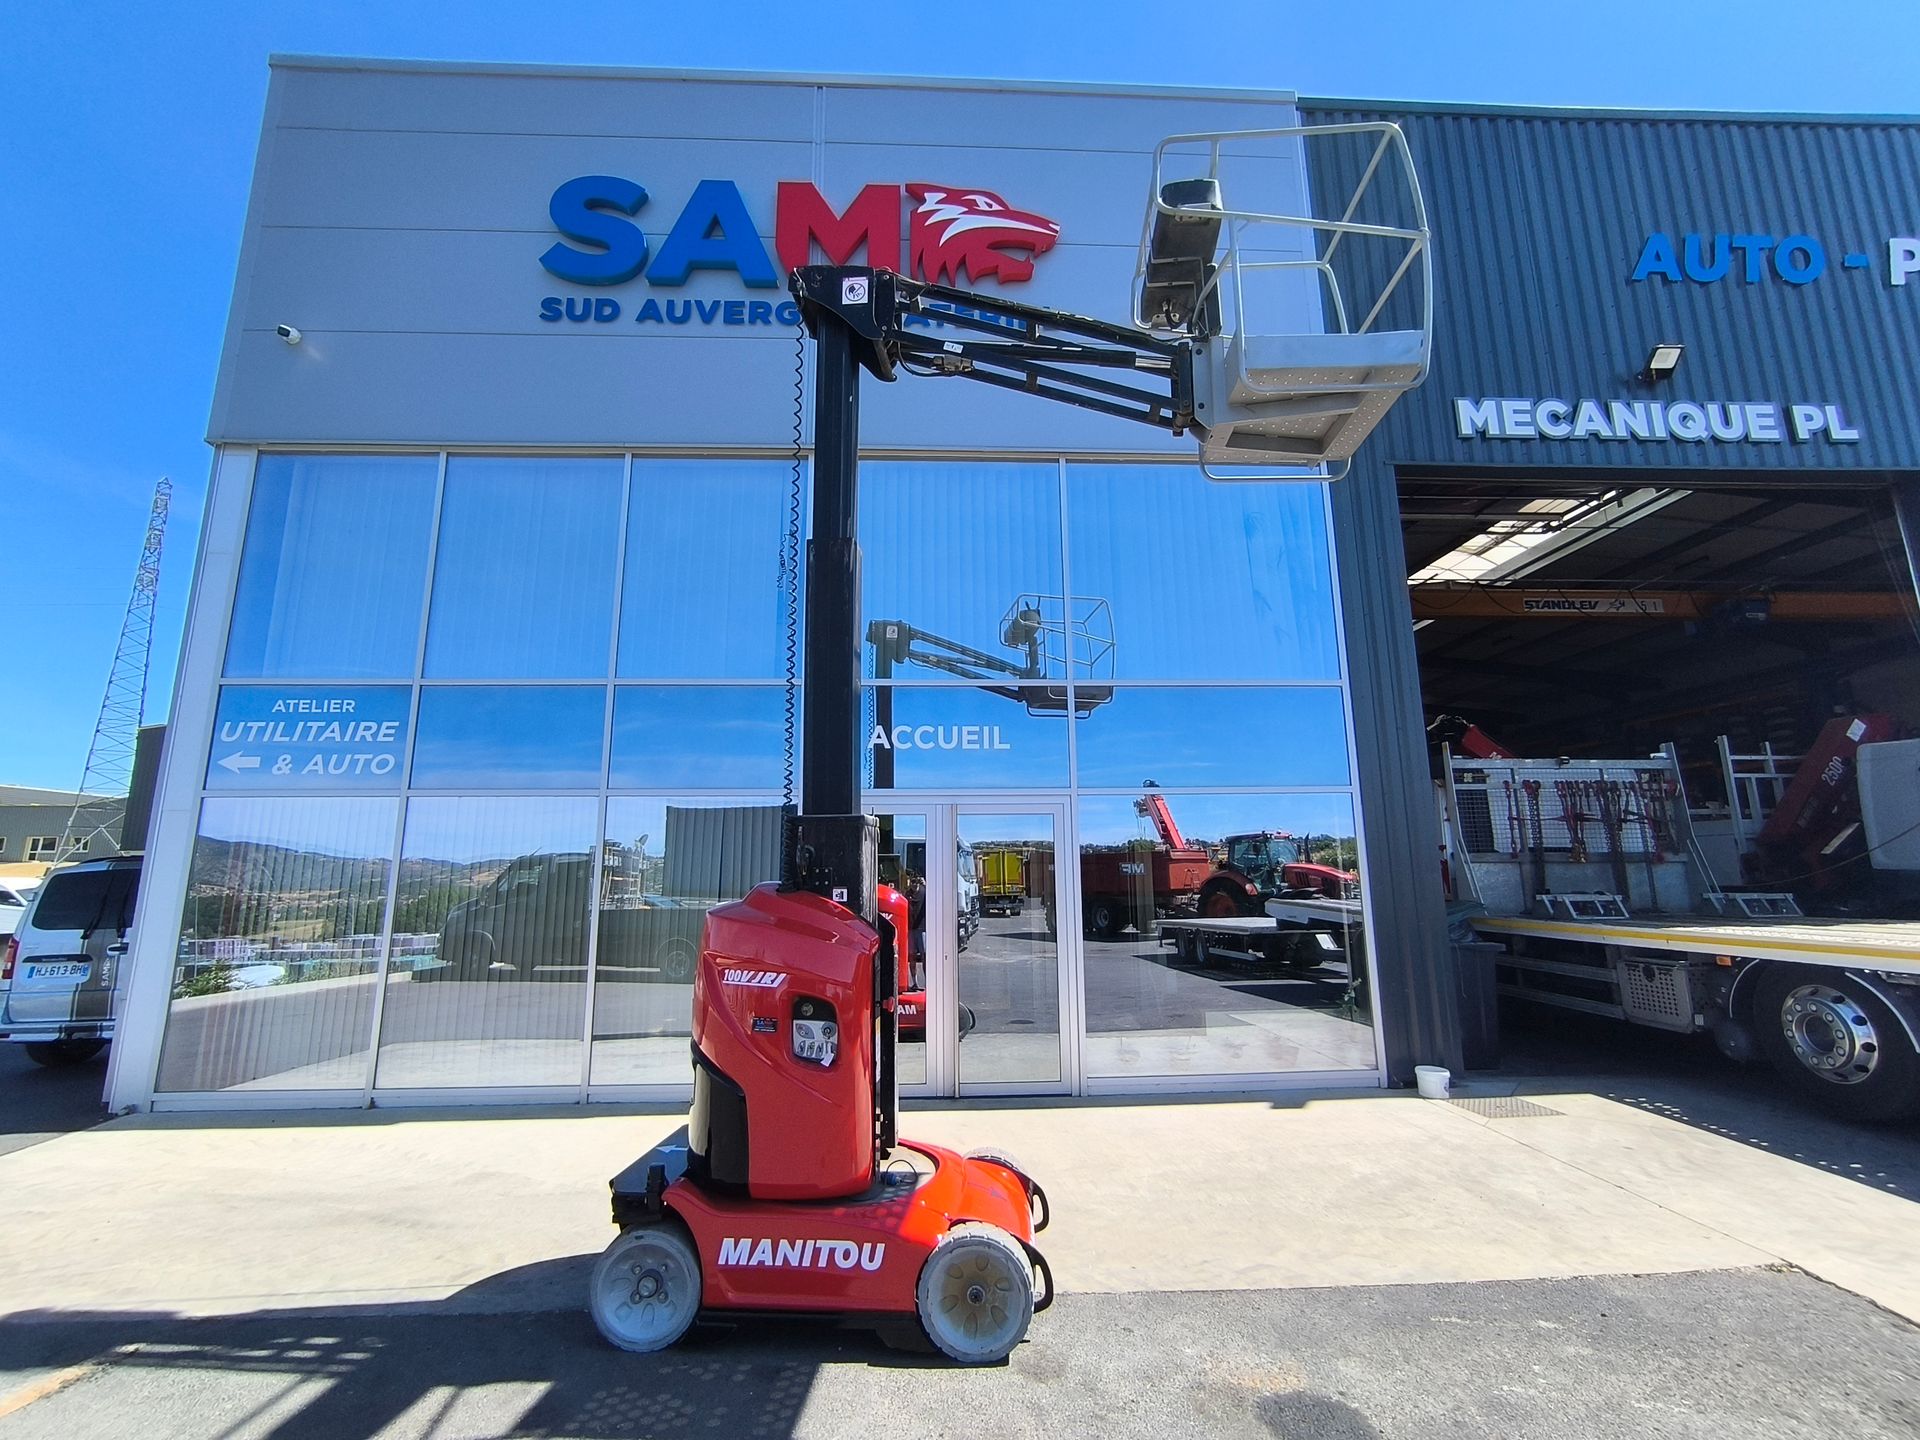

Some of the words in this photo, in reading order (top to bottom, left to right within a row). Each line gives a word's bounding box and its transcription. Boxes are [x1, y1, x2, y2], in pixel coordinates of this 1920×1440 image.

[538, 174, 901, 286] SAM
[1631, 232, 1827, 284] AUTO
[538, 296, 621, 323] SUD
[635, 298, 801, 326] AUVERG
[1454, 397, 1781, 442] MECANIQUE
[1790, 404, 1859, 443] PL
[271, 699, 355, 713] ATELIER
[219, 721, 400, 743] UTILITAIRE
[867, 724, 1011, 750] ACCUEIL
[271, 754, 293, 775] &
[301, 754, 396, 775] AUTO
[717, 1237, 886, 1271] MANITOU
